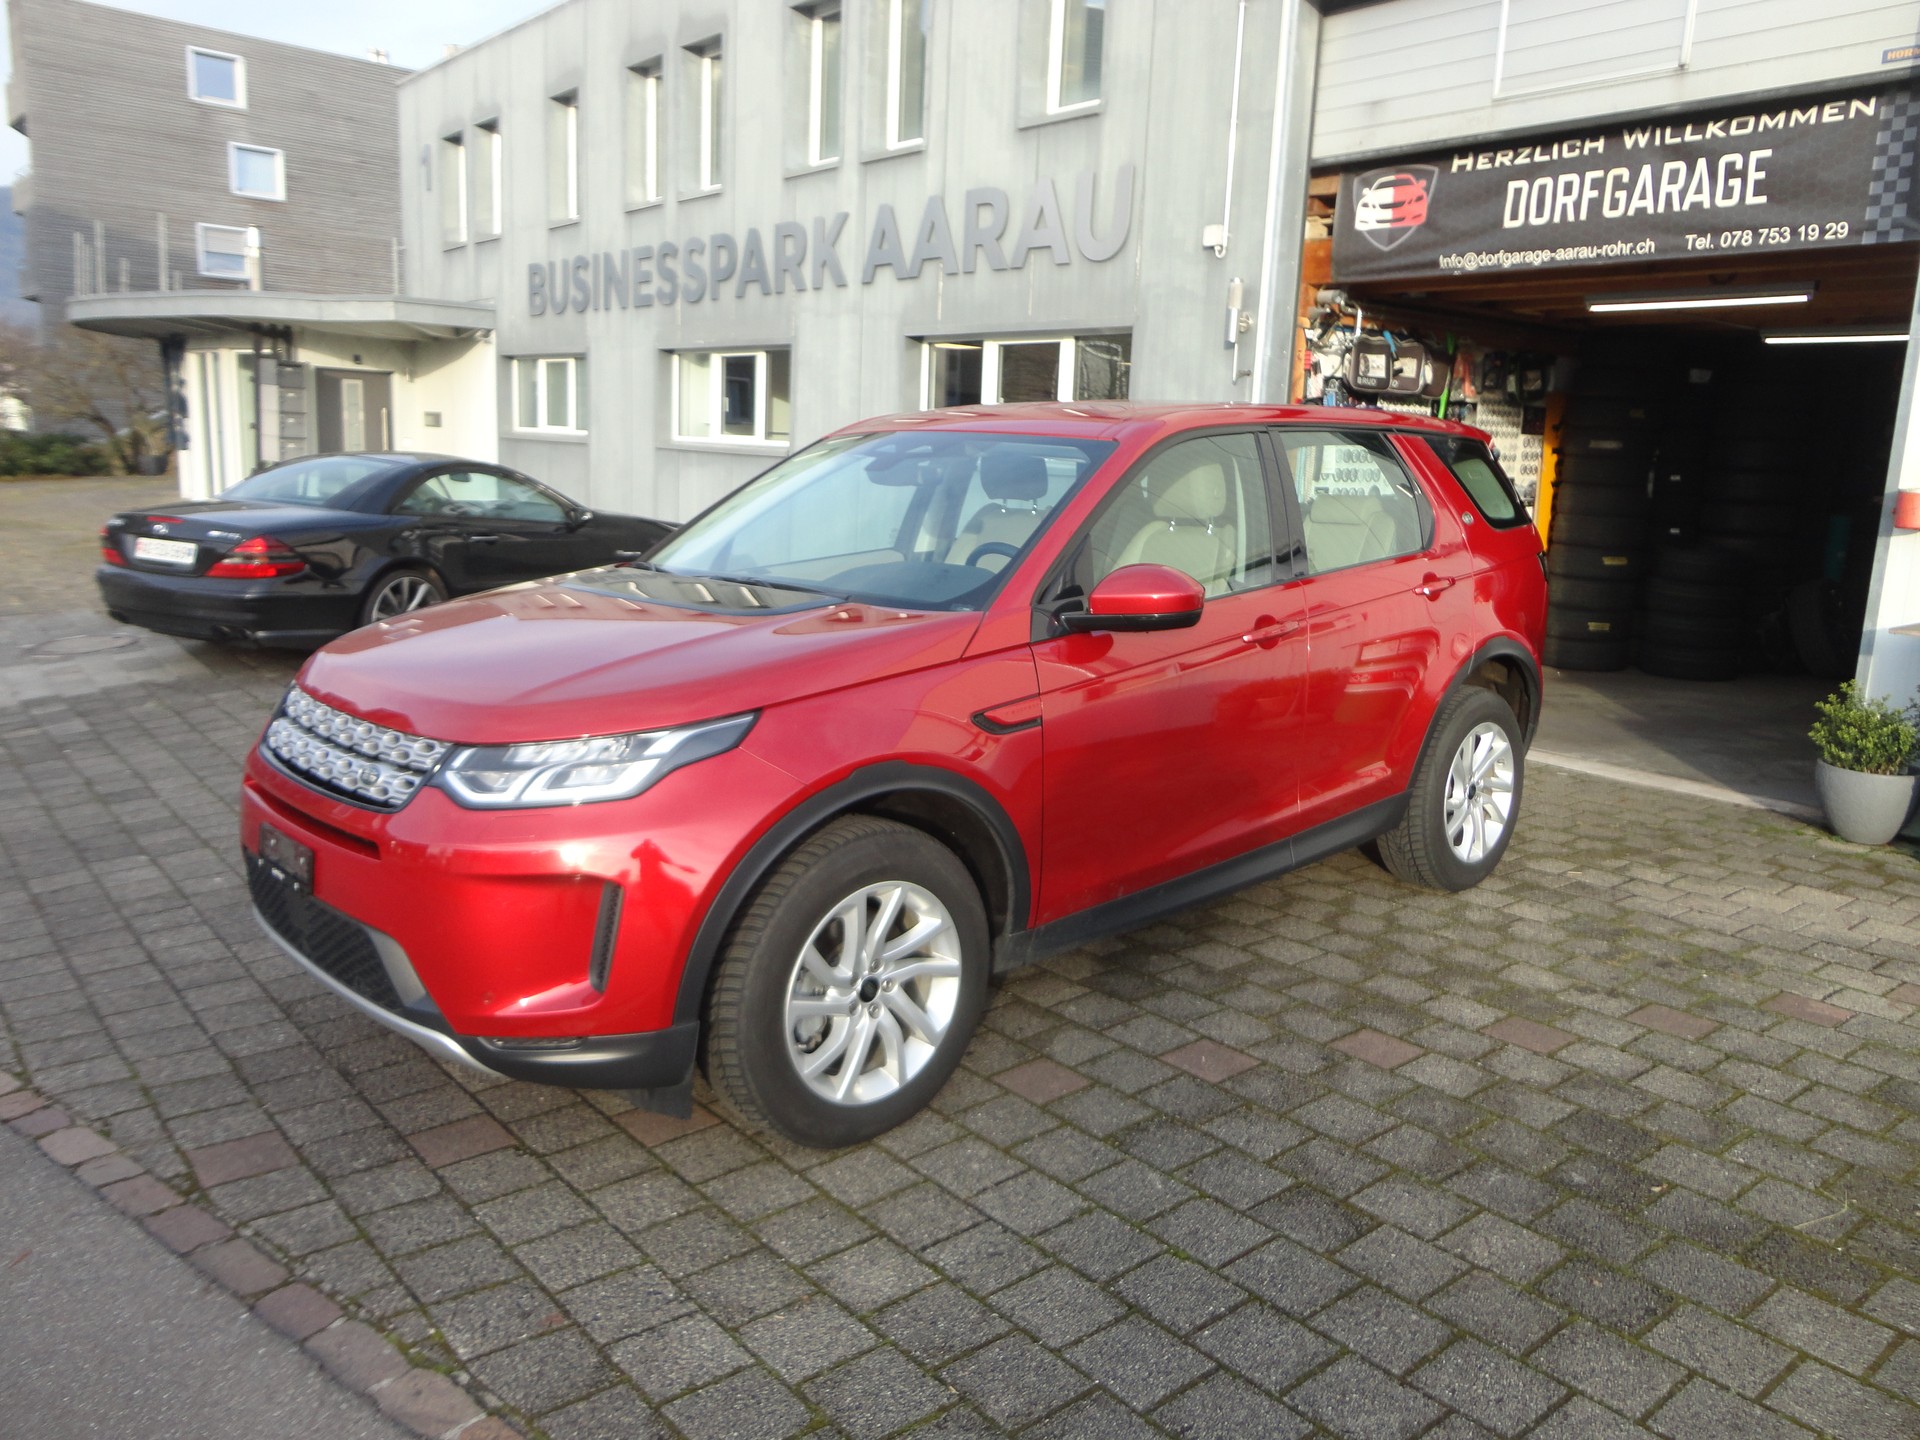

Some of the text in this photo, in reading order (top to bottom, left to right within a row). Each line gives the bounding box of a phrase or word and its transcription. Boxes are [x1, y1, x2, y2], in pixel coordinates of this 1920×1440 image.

[1450, 96, 1877, 174] HERZLICH WILLKOMMEN
[1502, 148, 1773, 230] DORFGARAGE
[527, 163, 1136, 317] BUSINESSPARK AARAU
[1684, 221, 1849, 251] Tel. 078 753 19 29
